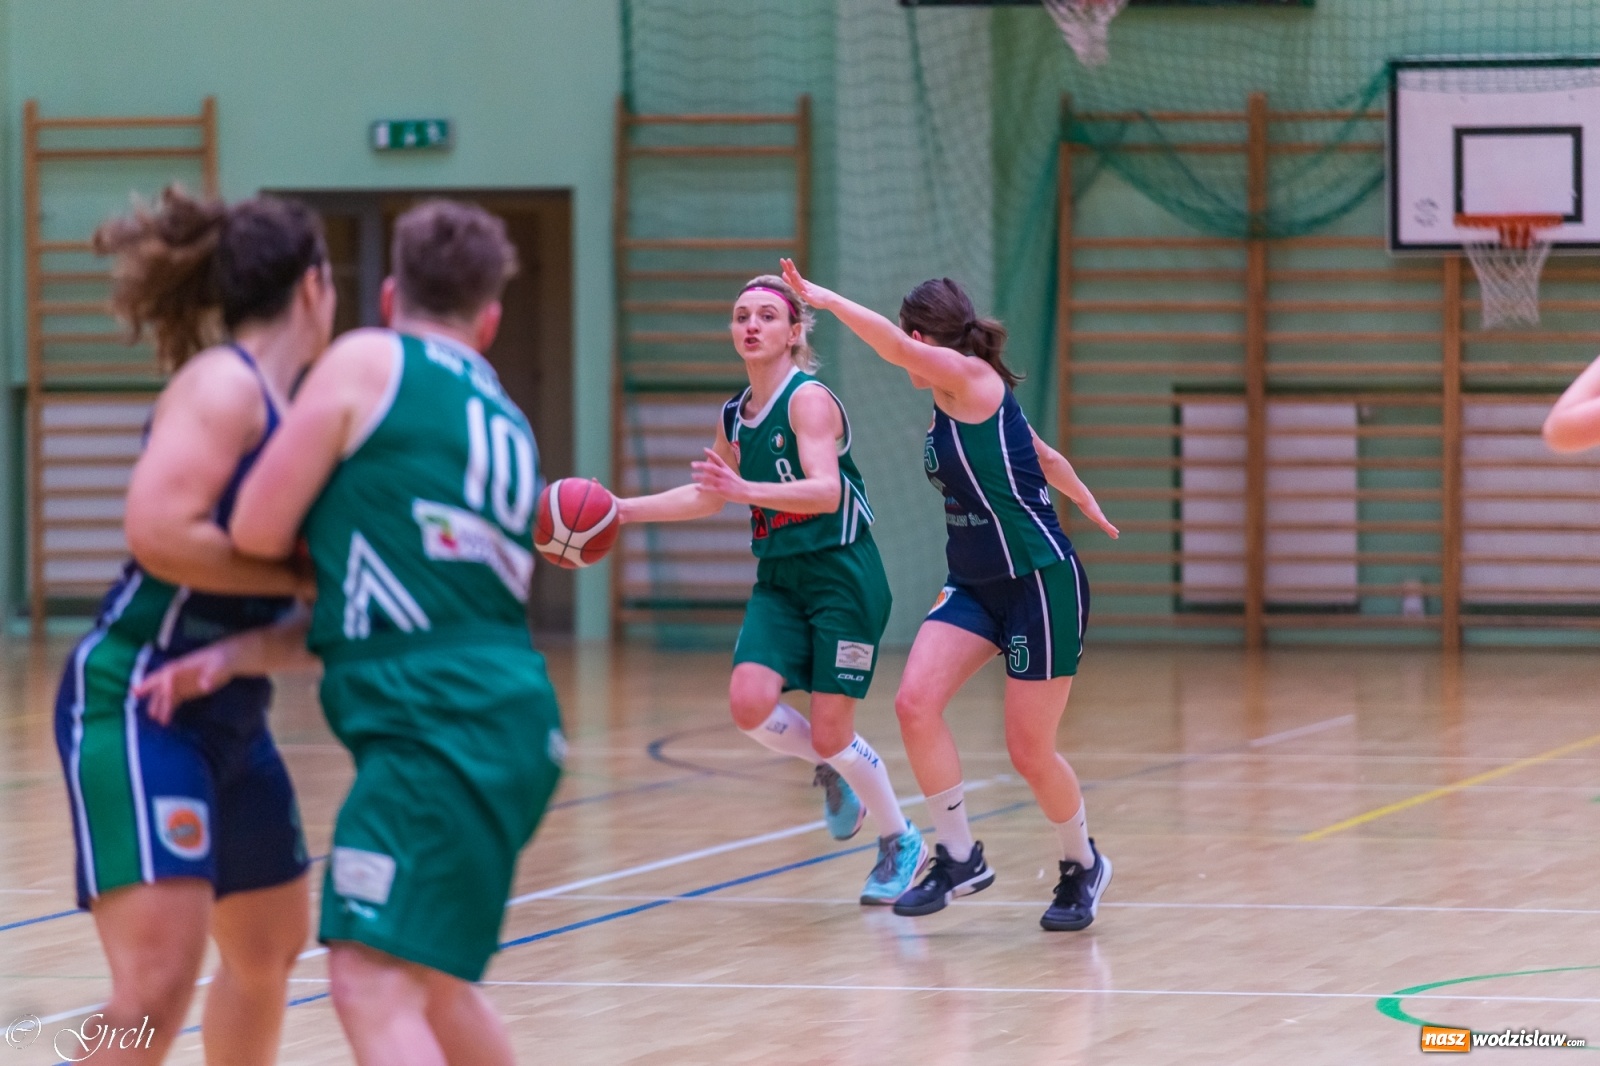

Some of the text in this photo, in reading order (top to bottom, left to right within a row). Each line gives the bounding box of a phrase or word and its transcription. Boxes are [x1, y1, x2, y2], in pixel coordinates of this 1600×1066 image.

[464, 397, 536, 535] 10
[775, 458, 797, 483] 8
[1008, 635, 1030, 673] 5
